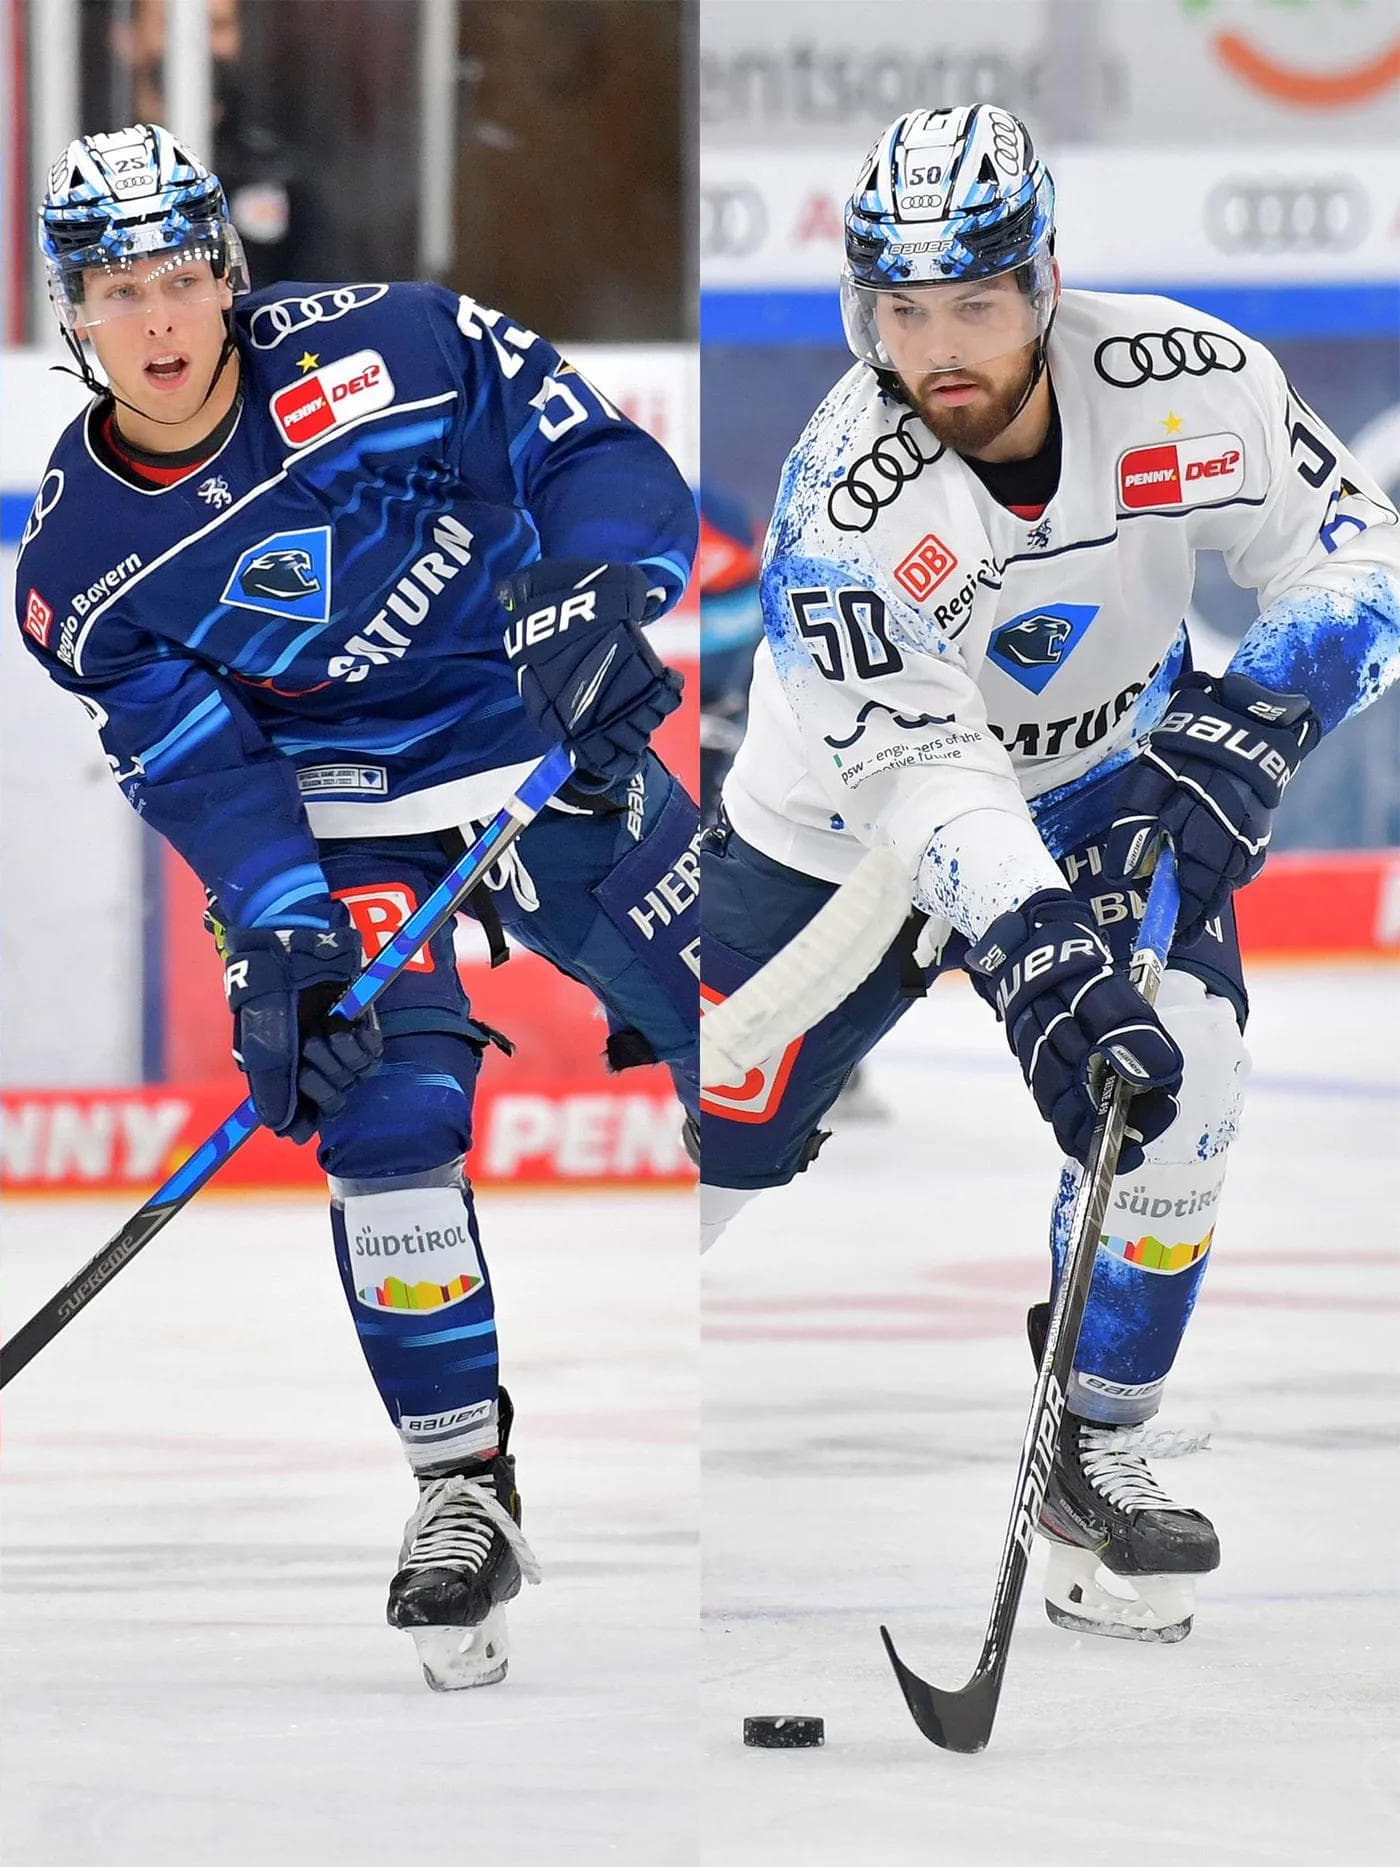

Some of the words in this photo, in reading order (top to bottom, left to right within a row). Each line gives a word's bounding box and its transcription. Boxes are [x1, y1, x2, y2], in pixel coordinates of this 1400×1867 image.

[115, 156, 146, 174] 25
[908, 166, 942, 186] 50
[888, 239, 954, 256] BAUER
[331, 364, 380, 403] DEL
[1185, 450, 1240, 481] DEL
[902, 545, 948, 594] DB
[56, 614, 79, 668] Regio
[71, 552, 143, 617] Bayern
[327, 515, 474, 683] SATURN
[790, 589, 904, 682] 50
[997, 939, 1097, 1015] UER
[58, 1235, 138, 1323] SUPREME
[1086, 1376, 1166, 1397] BAUE
[408, 1404, 488, 1431] BAUER
